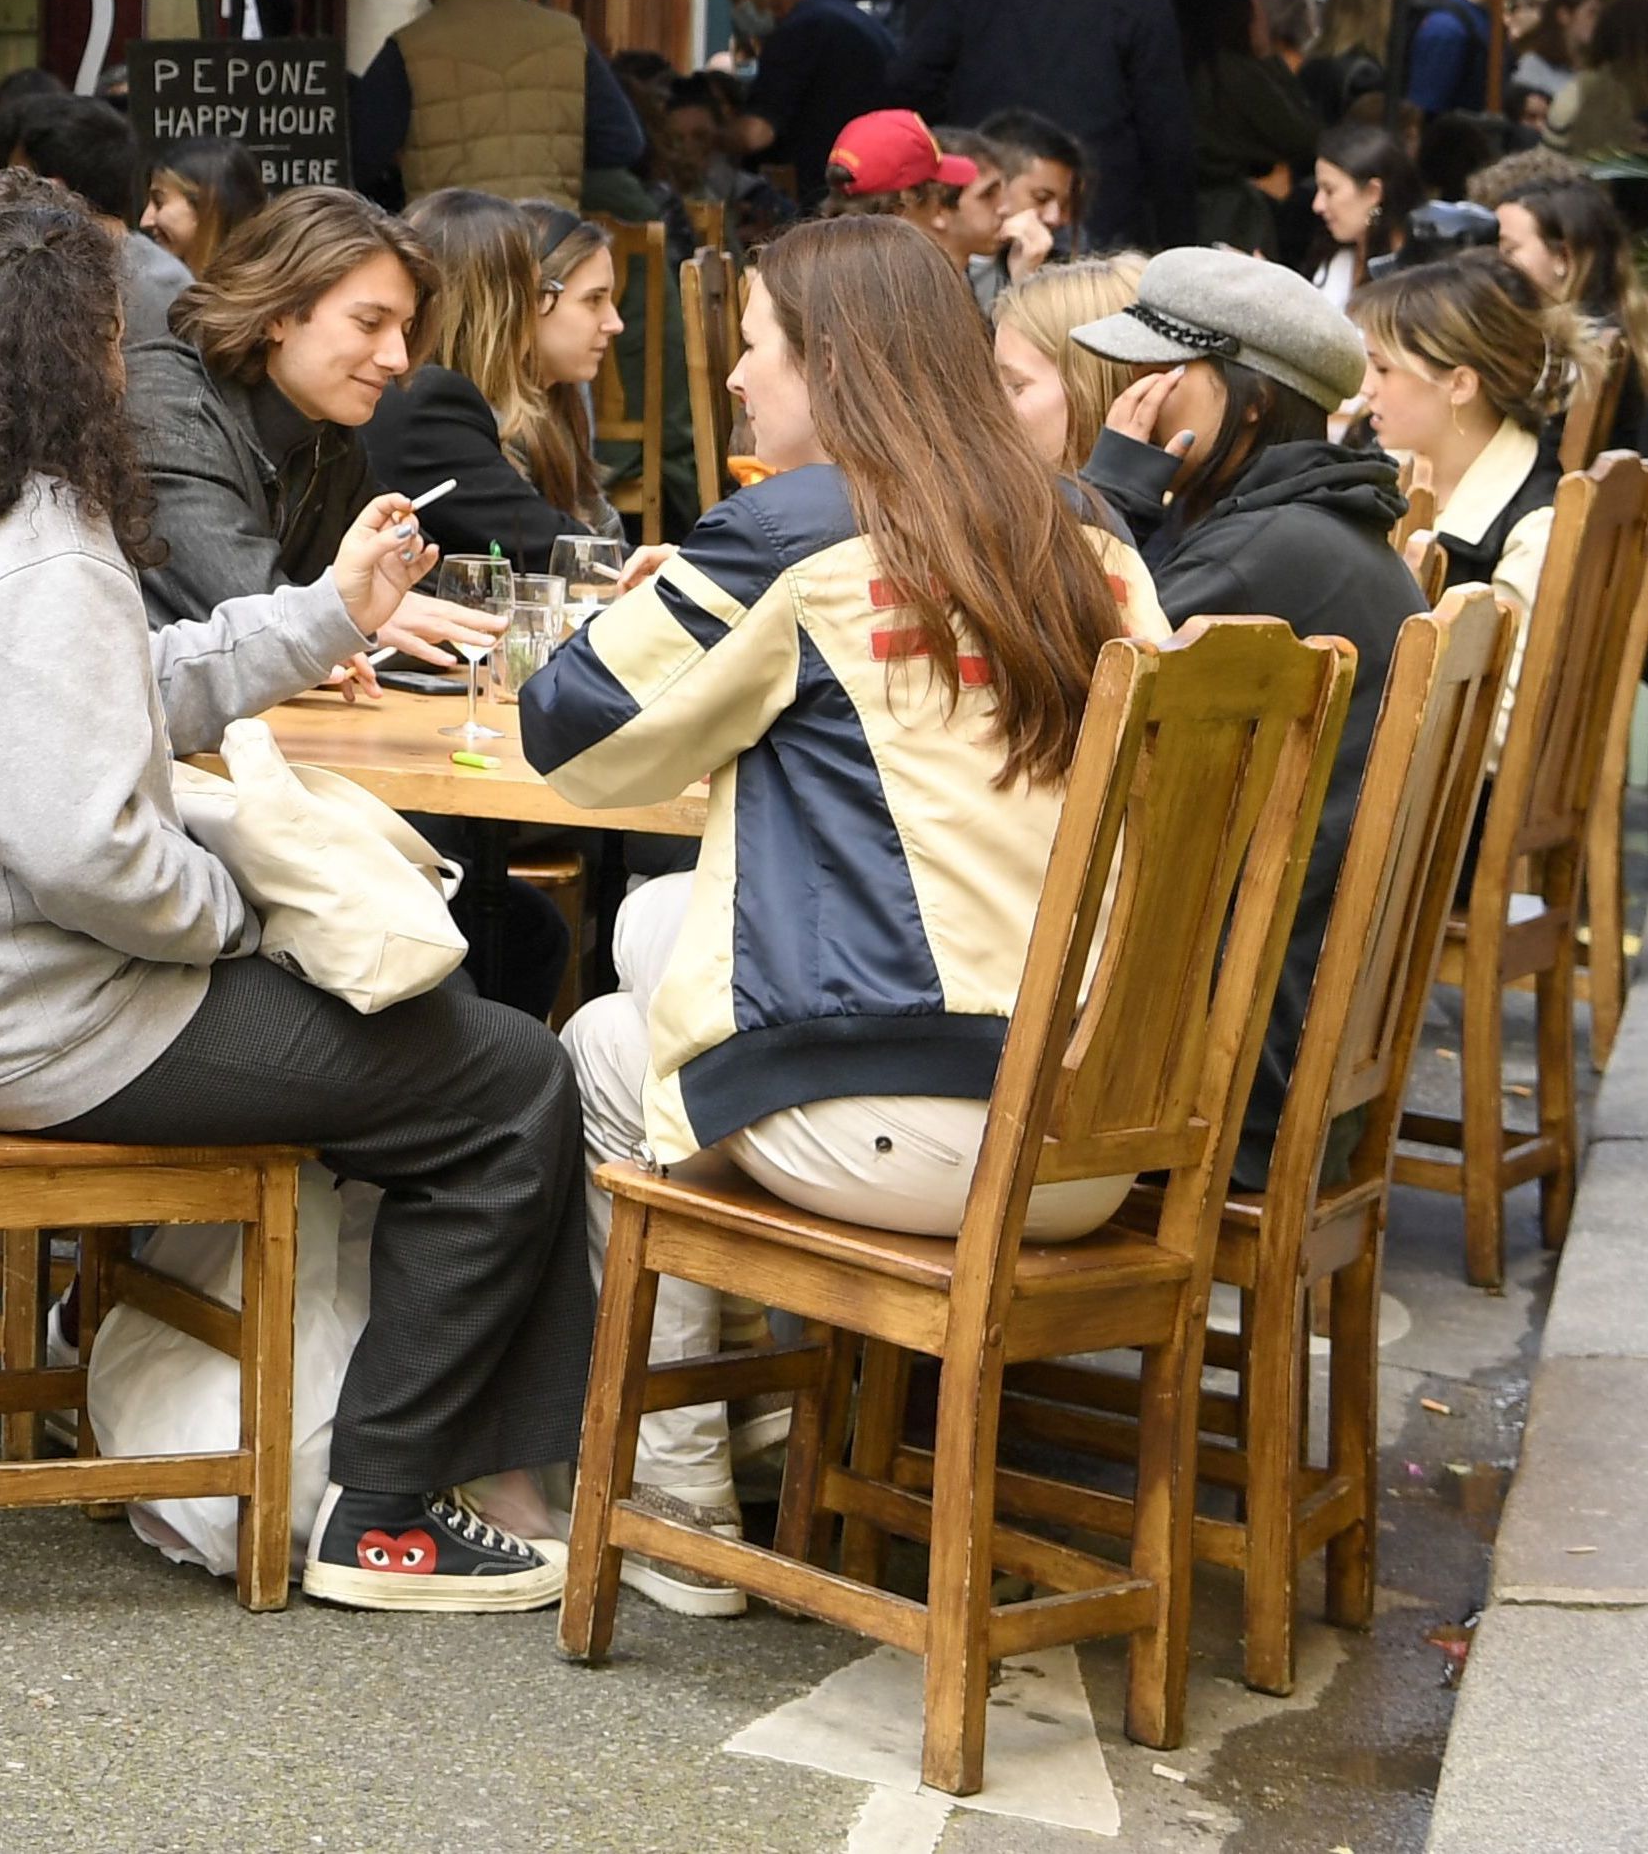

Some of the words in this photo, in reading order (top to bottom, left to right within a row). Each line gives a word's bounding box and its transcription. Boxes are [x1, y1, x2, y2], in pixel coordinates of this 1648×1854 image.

[153, 57, 328, 96] PEPONE
[153, 104, 249, 139] HAPPY
[259, 105, 337, 136] HOUR
[261, 159, 338, 185] BIERE
